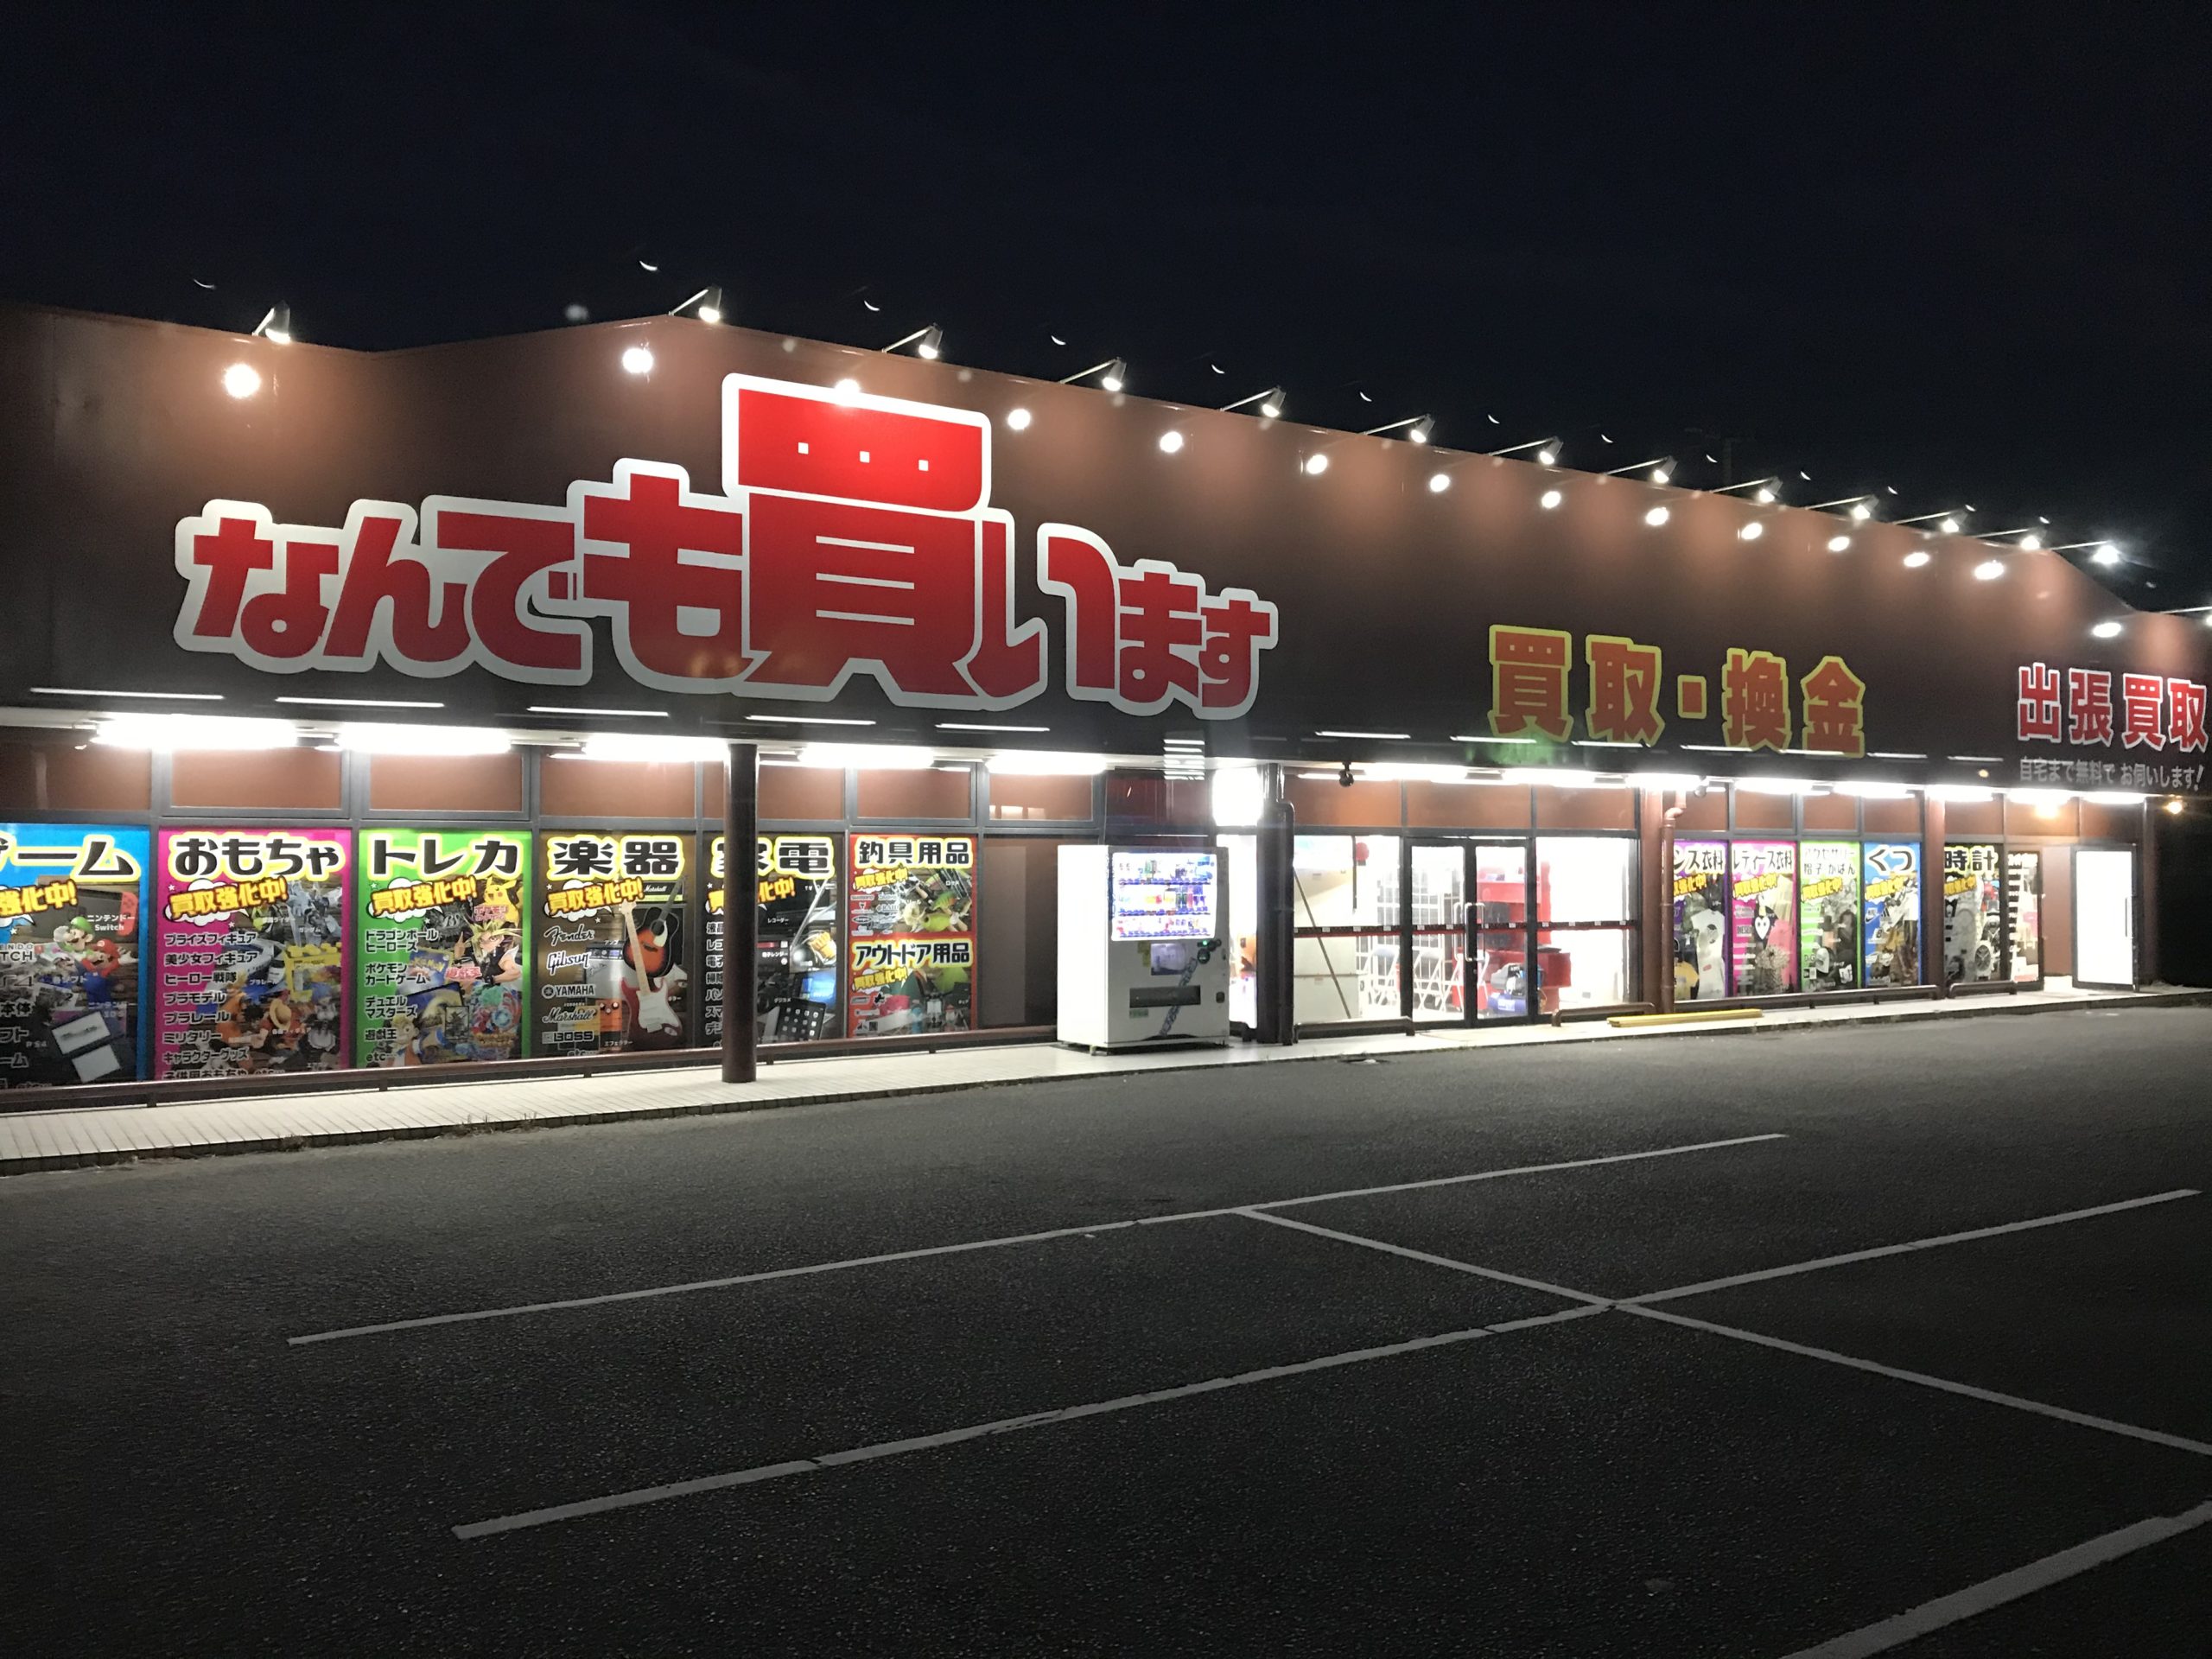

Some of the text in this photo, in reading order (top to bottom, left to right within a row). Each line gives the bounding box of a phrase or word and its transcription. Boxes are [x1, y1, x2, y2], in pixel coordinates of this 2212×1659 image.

[1488, 624, 1866, 758] 買取・換金
[2018, 662, 2209, 753] 出張買取
[0, 837, 134, 875] ーム
[175, 838, 340, 876] おもちゃ
[372, 837, 518, 875] トレカ
[553, 839, 679, 875] 楽器
[859, 841, 969, 864] 釣具用品
[1869, 849, 1913, 872] くつ
[1944, 849, 1995, 871] 時計
[169, 877, 288, 918] 買取強化中!
[372, 875, 479, 917] 買取強化中!
[547, 877, 645, 916] 買取強化中!
[164, 932, 257, 946] プライズフィギュア
[365, 929, 438, 944] ドラゴンボール
[543, 924, 595, 946] Fender
[365, 942, 418, 953] ヒーローズ
[855, 942, 969, 966] アウトドア用品
[164, 951, 258, 965] 美少女フィギュア
[546, 951, 592, 976] Gibson
[365, 963, 407, 974] ポケモン
[164, 972, 238, 985] ヒーロー戦隊
[365, 974, 427, 986] カードゲーム
[163, 992, 226, 1005] プラモデル
[556, 984, 595, 997] YAMAHA
[365, 996, 407, 1008] デュエル
[163, 1012, 231, 1025] プラレール
[365, 1007, 416, 1019] マスターズ
[542, 1007, 596, 1023] Marshall
[163, 1031, 222, 1044] ミリタリー
[365, 1029, 397, 1041] 遊戯王
[553, 1031, 594, 1042] BOSS
